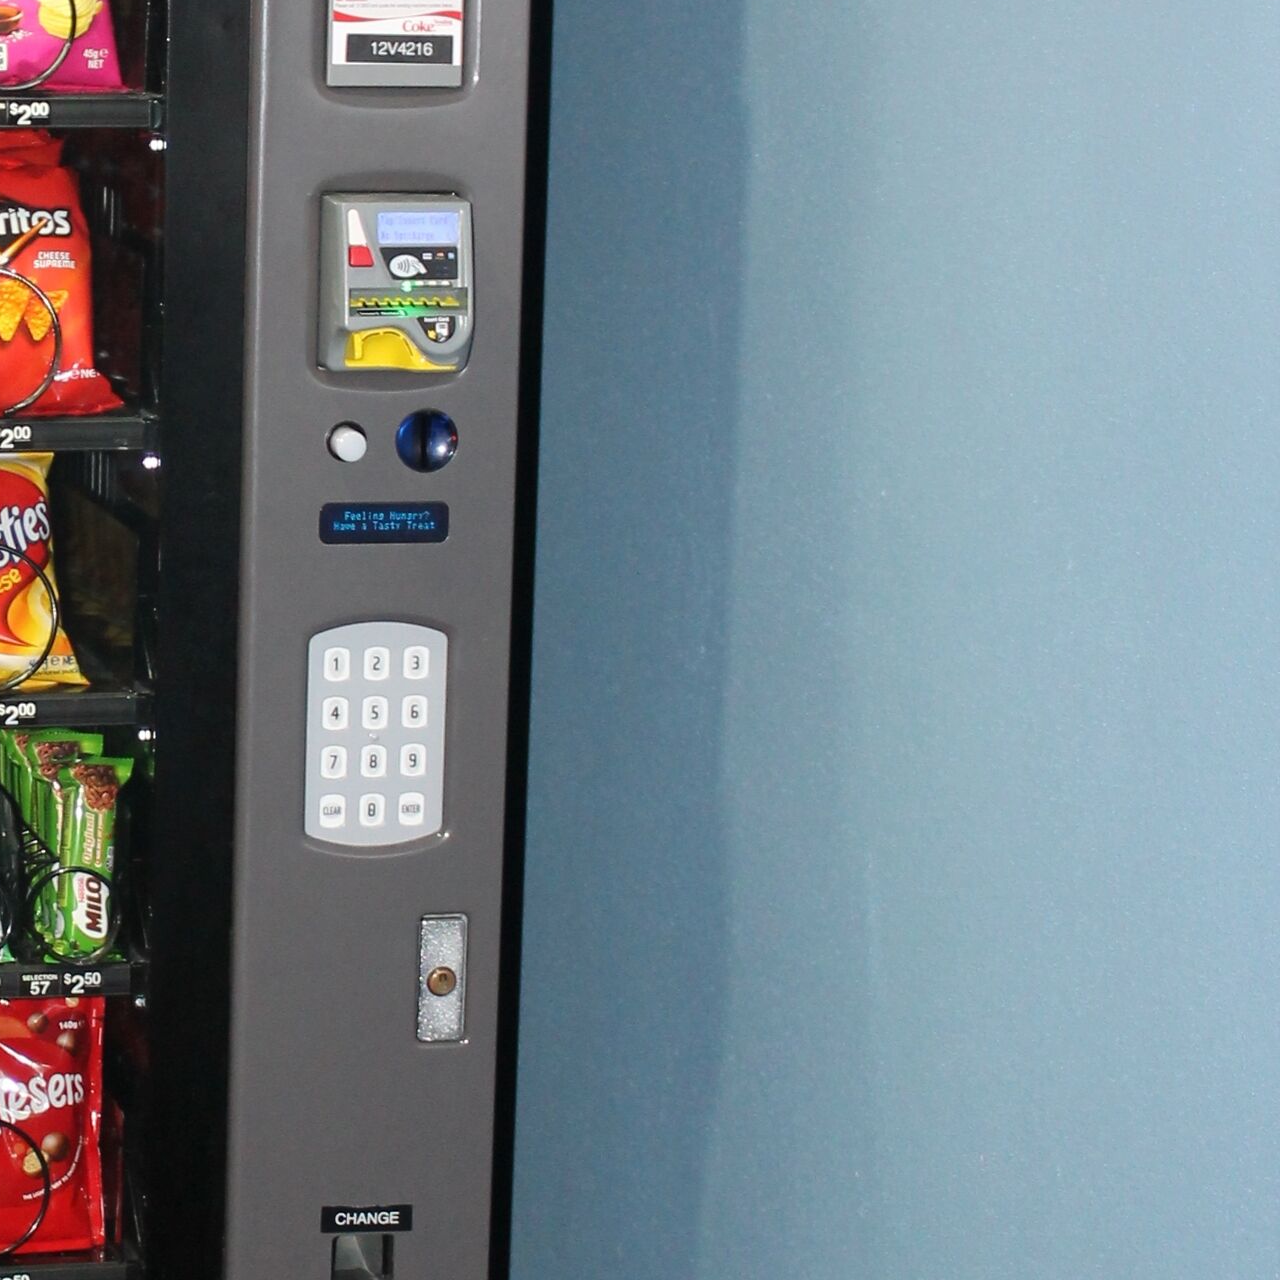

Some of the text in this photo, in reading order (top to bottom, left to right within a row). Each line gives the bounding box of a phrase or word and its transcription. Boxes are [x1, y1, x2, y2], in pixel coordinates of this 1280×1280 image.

[402, 20, 435, 33] Coke
[370, 40, 434, 57] 12V4216
[87, 59, 105, 70] NET
[37, 251, 71, 260] CHEESE
[33, 260, 76, 269] SUPREME
[344, 511, 431, 521] Feeling Hungry?
[333, 522, 436, 531] Have Tasty Treat
[332, 657, 339, 671] 1
[373, 656, 381, 671] 2
[411, 656, 420, 670] 3
[331, 706, 340, 720] 4
[371, 705, 379, 720] 5
[410, 704, 419, 719] 6
[329, 755, 338, 769] 7
[369, 753, 377, 768] 8
[409, 752, 417, 767] 9
[322, 806, 342, 816] CLEAR
[367, 803, 376, 817] 0
[401, 804, 421, 814] ENTER
[81, 811, 95, 865] Original
[85, 876, 102, 934] MILO
[29, 981, 51, 996] 57
[334, 1211, 400, 1226] CHANGE
